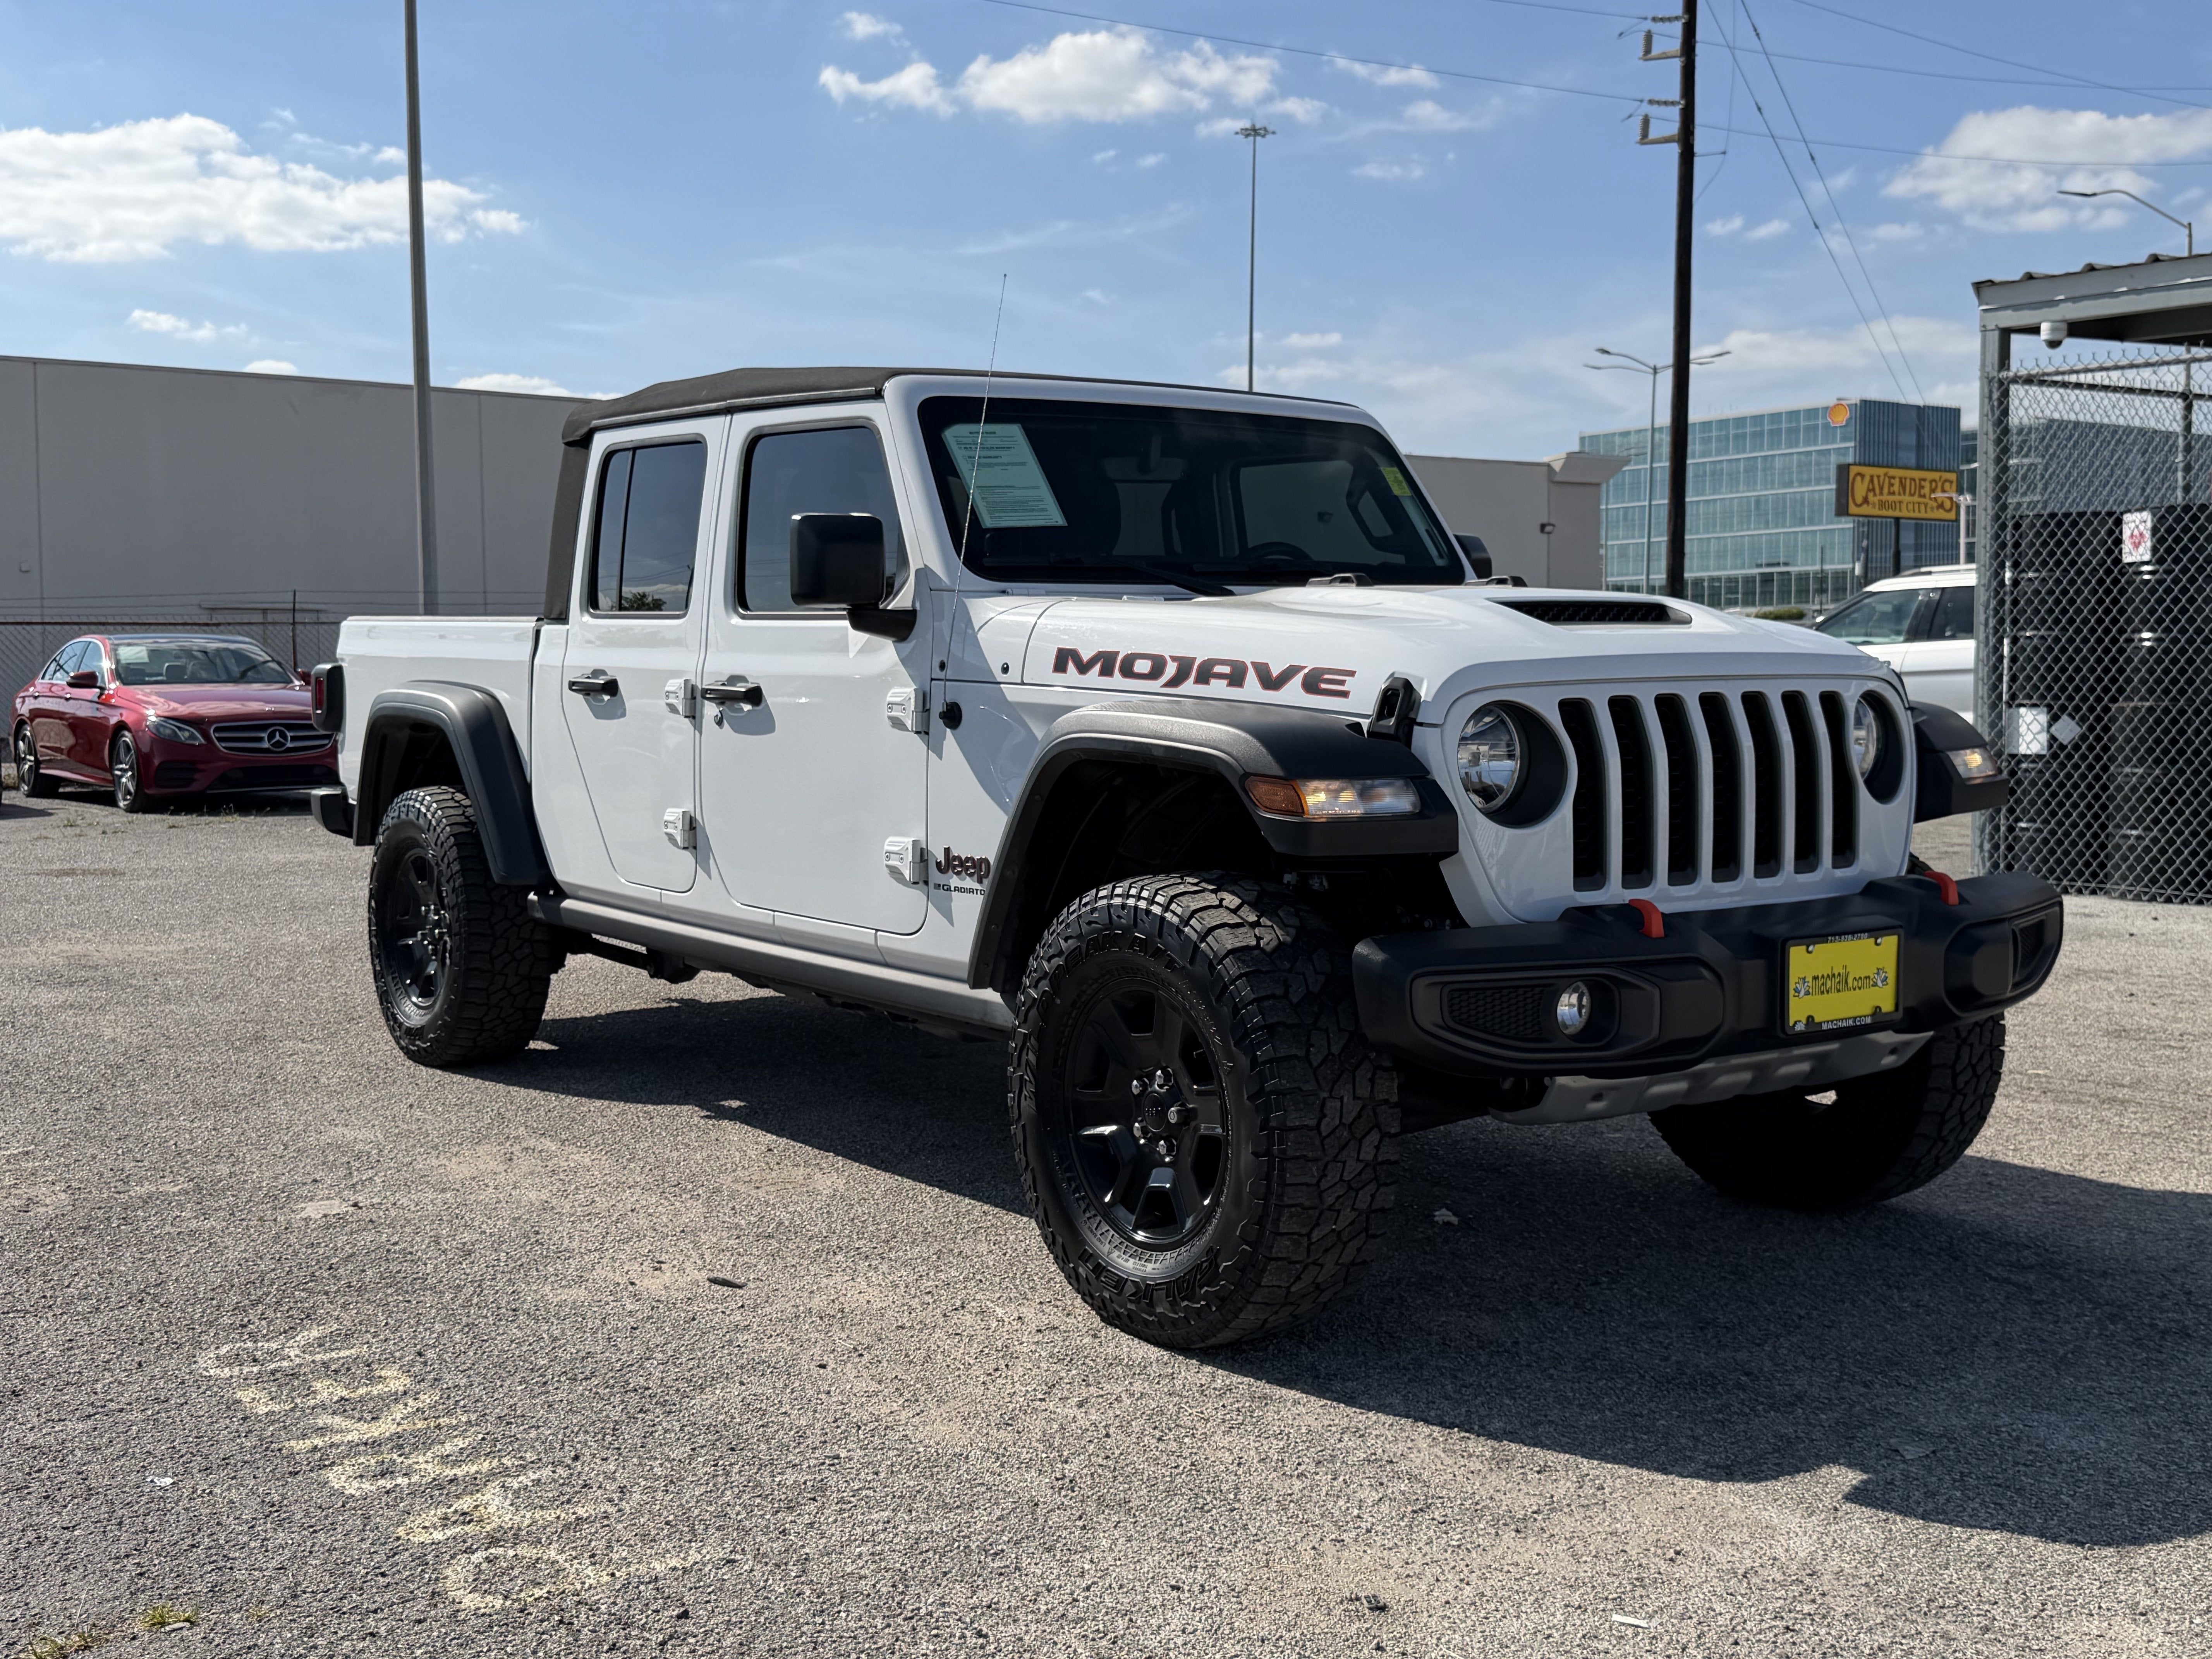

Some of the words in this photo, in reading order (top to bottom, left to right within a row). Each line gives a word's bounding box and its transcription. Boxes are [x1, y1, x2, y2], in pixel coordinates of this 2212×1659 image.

[1850, 472, 1954, 512] CAVENDER'S
[1878, 500, 1904, 513] BOOT
[1906, 501, 1928, 514] CITY
[1052, 646, 1357, 699] MOJAVE
[936, 845, 991, 884] Jeep
[942, 884, 985, 895] GLADIATO
[1812, 965, 1870, 996] machaik.com
[1822, 1016, 1871, 1030] MACHAIK.COM
